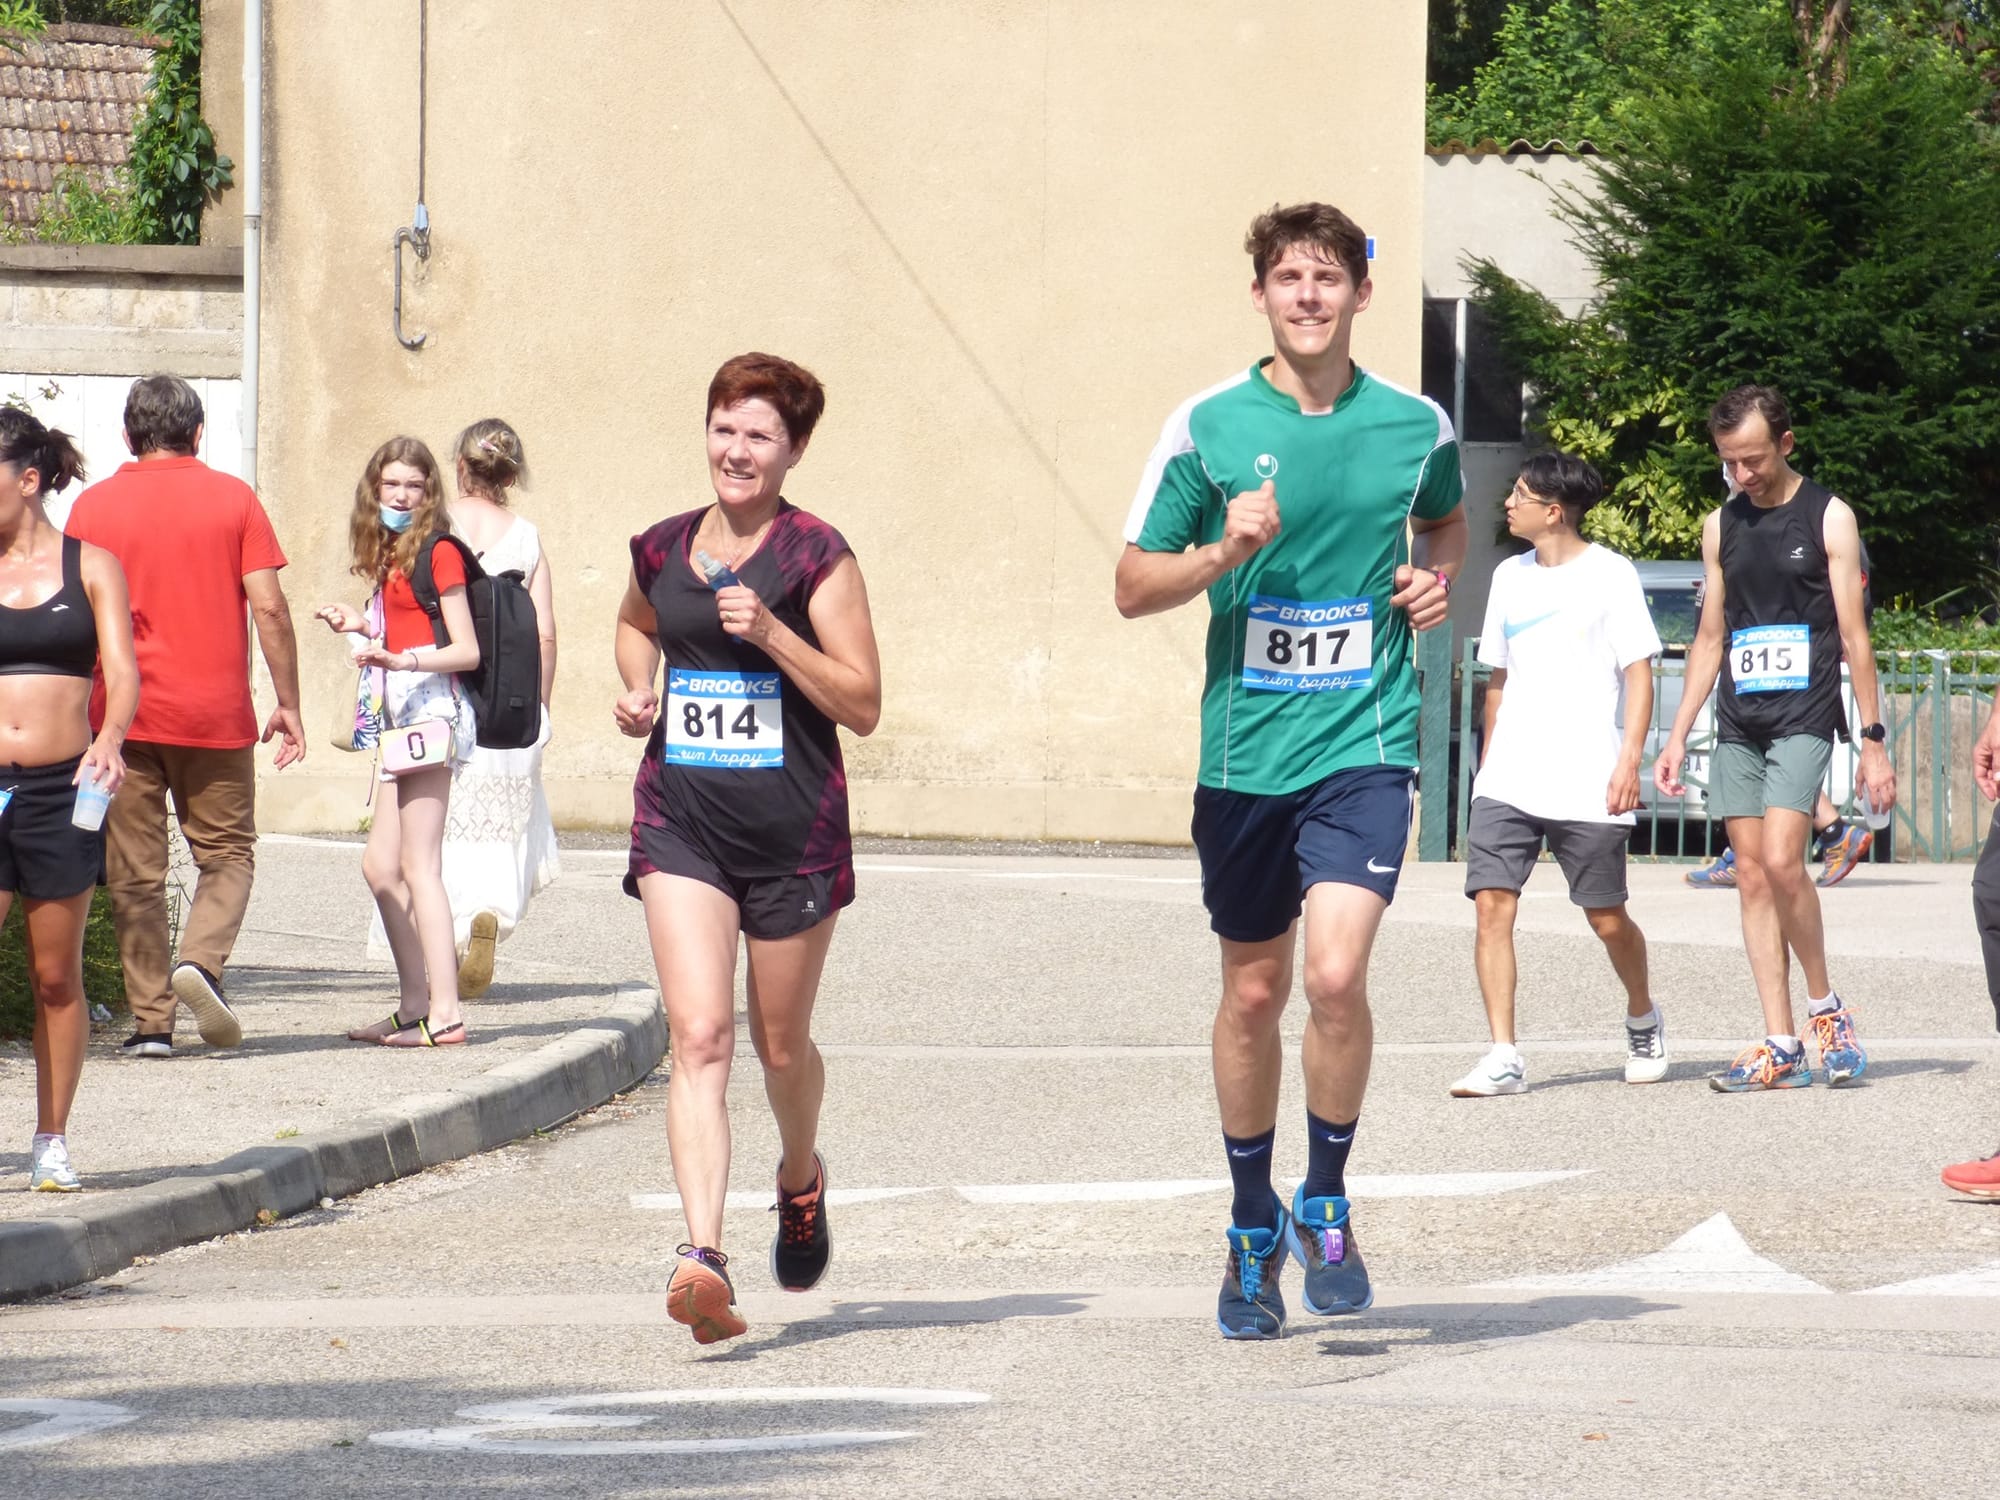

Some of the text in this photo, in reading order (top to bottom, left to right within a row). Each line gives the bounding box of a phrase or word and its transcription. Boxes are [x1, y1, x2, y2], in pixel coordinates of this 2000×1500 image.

[1278, 602, 1369, 622] BROOKS
[1745, 629, 1806, 643] BROOKS
[1266, 628, 1351, 667] 817
[1740, 647, 1793, 674] 815
[688, 678, 777, 694] BROOKS
[1261, 674, 1353, 690] run happy
[682, 701, 760, 740] 814
[679, 749, 763, 768] run happy
